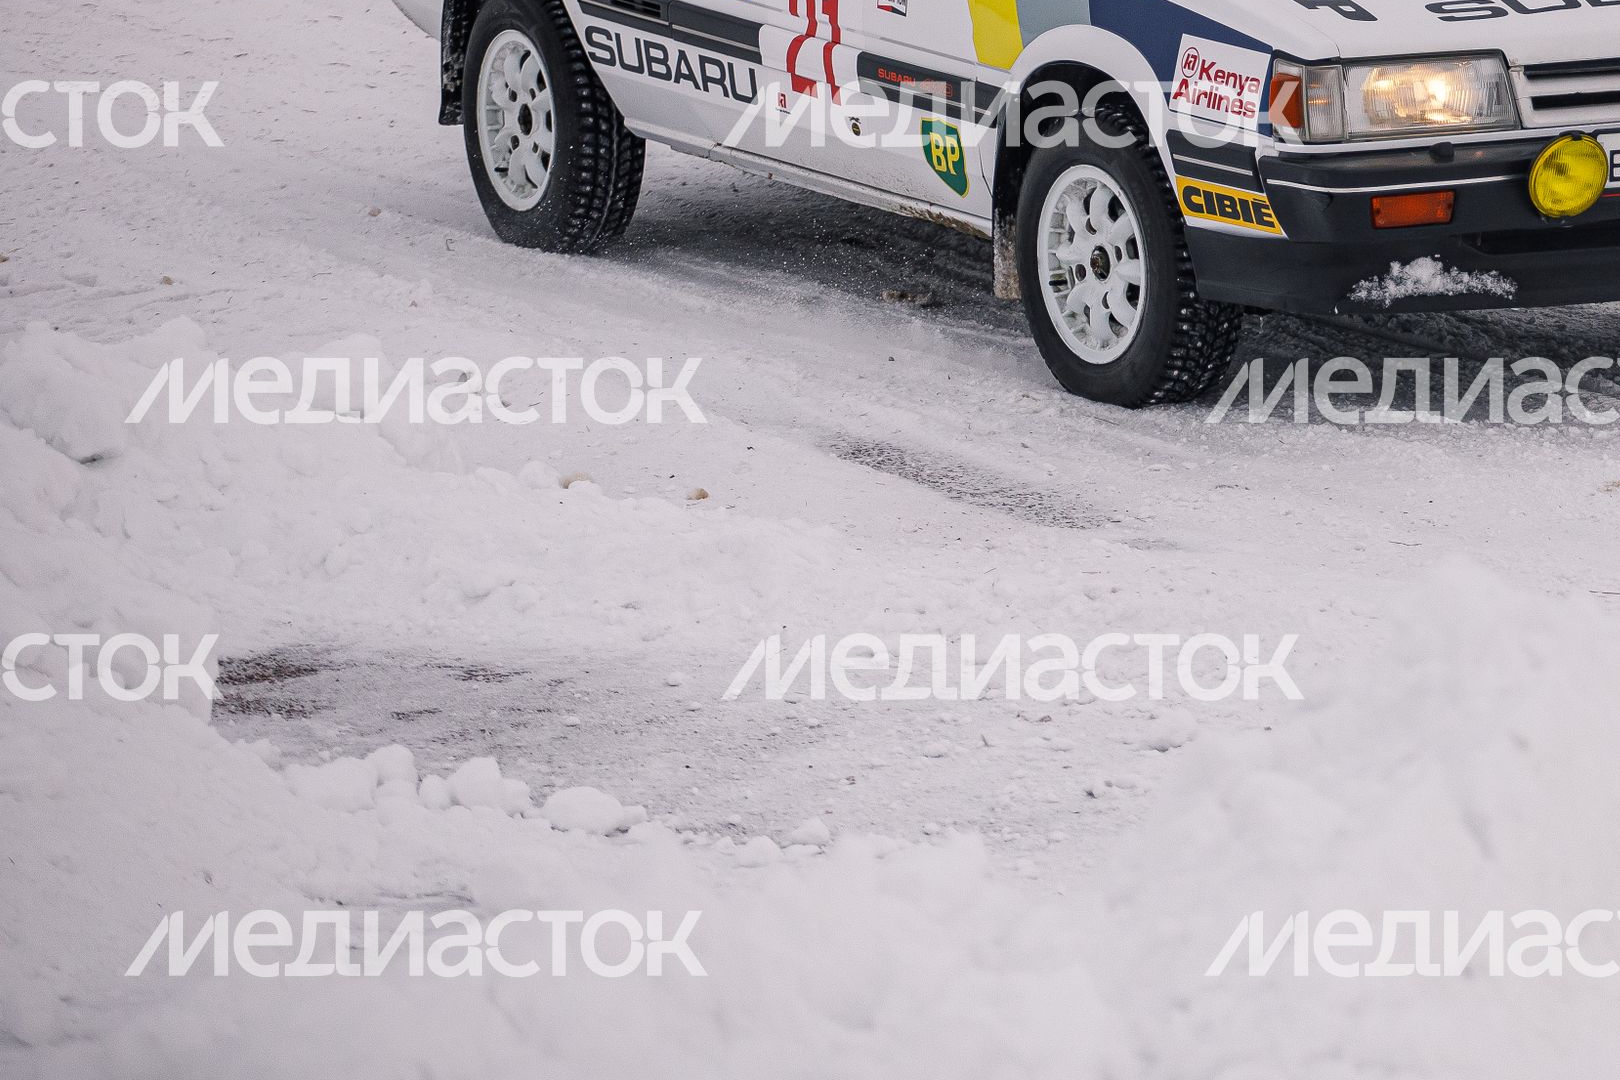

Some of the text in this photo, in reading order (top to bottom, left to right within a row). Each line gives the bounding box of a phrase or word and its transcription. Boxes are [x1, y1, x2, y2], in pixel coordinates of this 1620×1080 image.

[584, 25, 758, 105] SUBARU
[878, 68, 916, 86] SUBARU
[1199, 59, 1261, 97] Kenya
[1172, 78, 1257, 119] Airlines
[929, 131, 960, 176] BP
